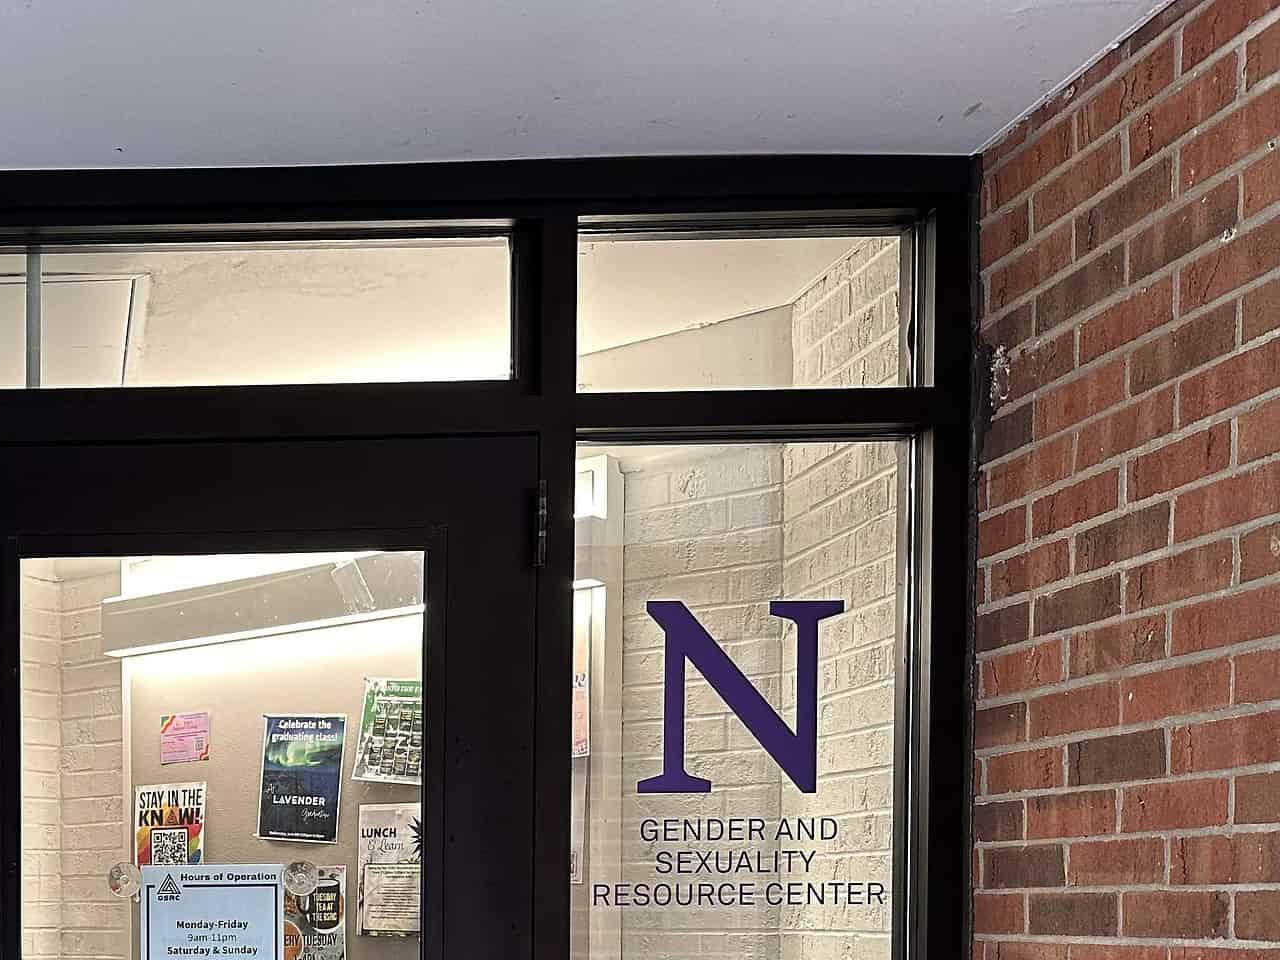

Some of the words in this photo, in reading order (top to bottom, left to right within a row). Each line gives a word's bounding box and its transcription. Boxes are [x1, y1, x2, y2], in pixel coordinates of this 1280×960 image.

[637, 600, 845, 794] N
[278, 720, 317, 729] Celebrate
[318, 720, 332, 729] the
[271, 732, 315, 743] graduating
[139, 791, 165, 809] STAY
[167, 789, 179, 808] IN
[181, 788, 203, 806] THE
[273, 794, 326, 806] LAVENDER
[361, 827, 397, 838] LUNCH
[640, 818, 766, 842] GENDER
[774, 817, 838, 841] AND
[378, 839, 405, 855] Learn
[655, 850, 817, 874] SEXUALITY
[180, 873, 210, 881] Hours
[213, 872, 224, 881] of
[226, 872, 277, 882] Operation
[593, 883, 756, 907] RESOURCE
[765, 882, 885, 906] CENTER
[176, 920, 249, 930] Monday-Friday
[187, 933, 237, 943] 9am-11pm
[302, 933, 338, 946] TUESDAY
[167, 946, 211, 956] Saturday
[212, 946, 220, 955] &
[222, 946, 258, 956] Sunday
